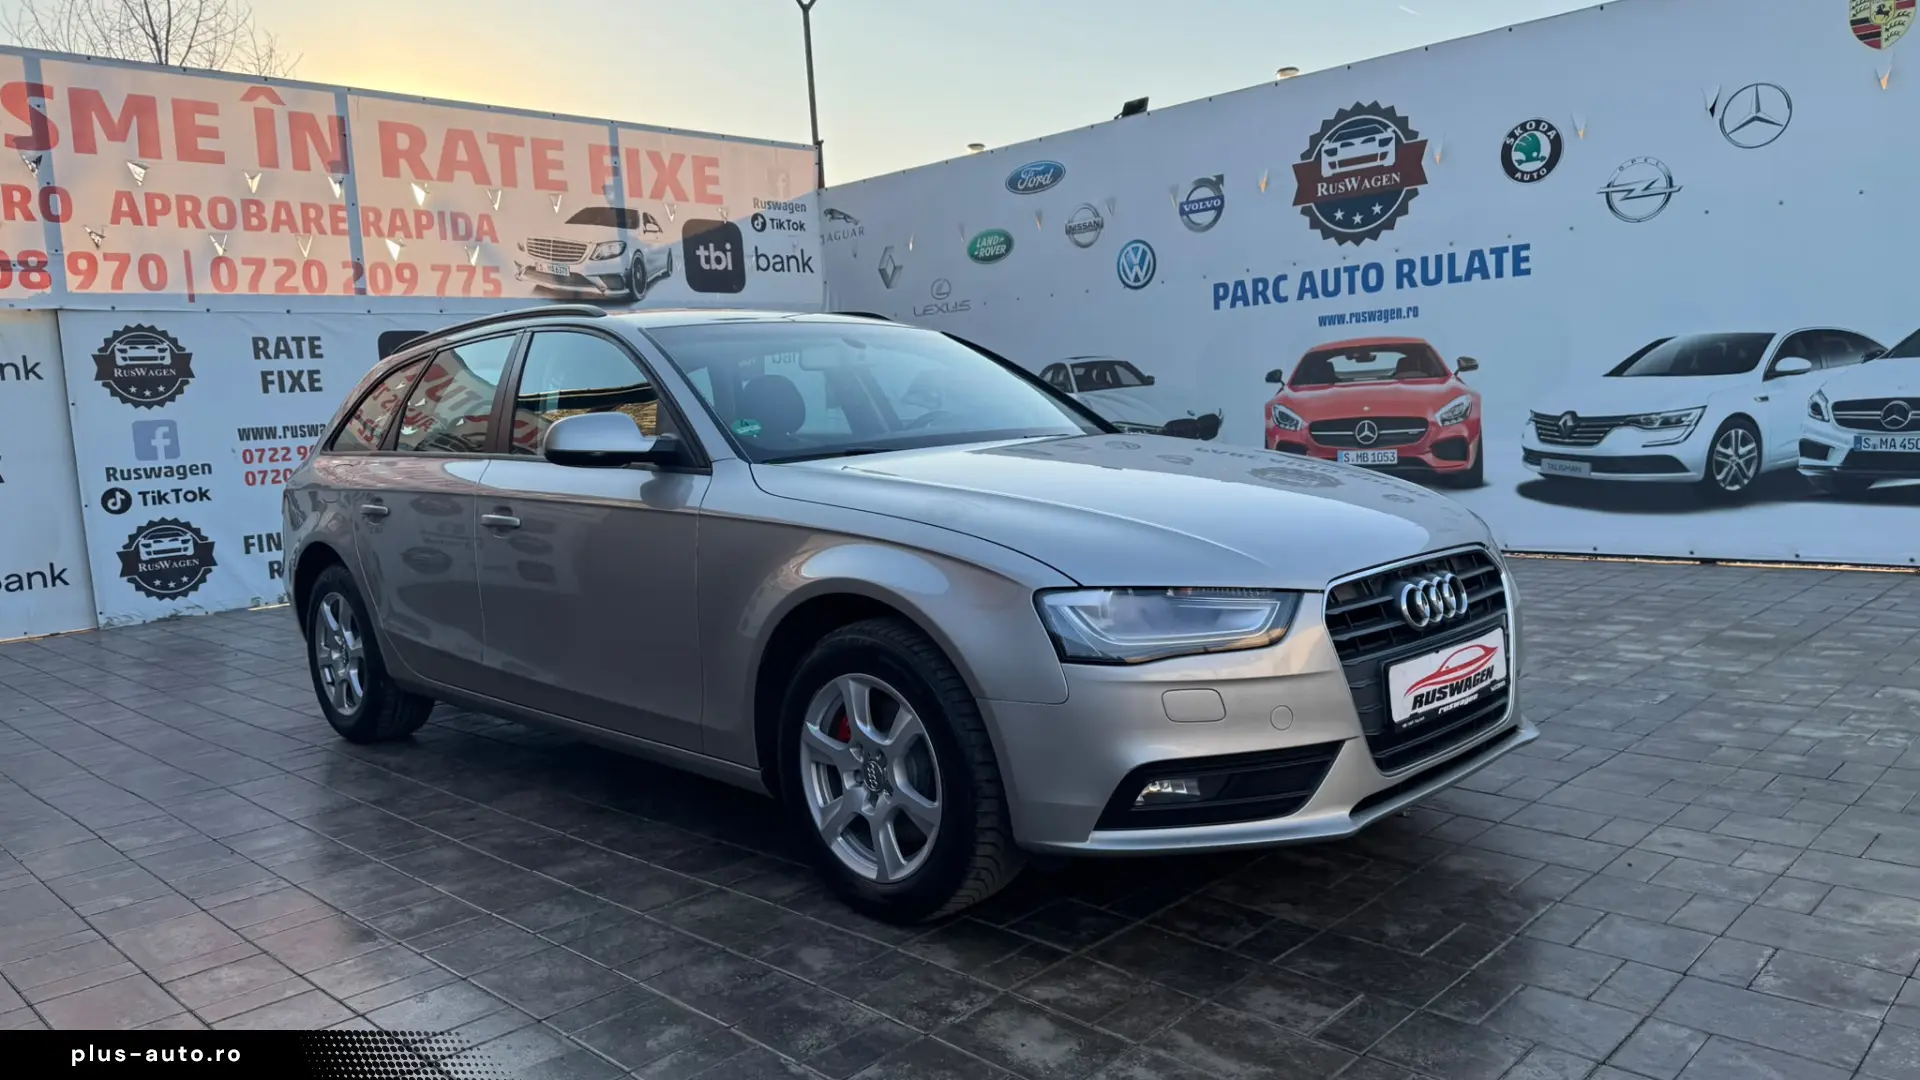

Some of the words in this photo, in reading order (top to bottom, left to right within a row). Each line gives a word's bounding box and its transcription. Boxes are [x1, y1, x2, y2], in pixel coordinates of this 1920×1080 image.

[1506, 120, 1557, 146] SKODA
[239, 86, 350, 175] ÎN
[377, 120, 568, 193] RATE
[588, 143, 725, 205] FIXE
[1017, 164, 1054, 190] Ford
[1514, 168, 1547, 181] AUTO
[752, 197, 807, 215] Ruswagen
[1183, 198, 1222, 212] VOLVO
[110, 190, 350, 236] APROBARE
[362, 205, 500, 244] RAPIDA
[769, 217, 806, 232] TikTok
[1068, 219, 1101, 232] NISSAN
[820, 226, 865, 245] JAGUAR
[696, 242, 734, 271] tbi
[755, 245, 815, 274] bank
[66, 250, 169, 292] 970
[209, 255, 329, 294] 0720
[341, 260, 421, 296] 209
[430, 262, 502, 297] 775
[1212, 273, 1289, 311] PARC
[1296, 261, 1385, 302] AUTO
[1395, 243, 1532, 290] RULATE
[913, 300, 972, 317] LEXUS
[1317, 305, 1419, 328] www.ruswagen.ro
[252, 335, 324, 361] RATE
[260, 369, 323, 394] FIXE
[242, 446, 292, 465] 0722
[1372, 452, 1395, 462] 1053
[105, 462, 213, 483] Ruswagen
[138, 486, 212, 507] TikTok
[0, 562, 70, 593] ank
[1411, 664, 1495, 711] RUSWAGEN
